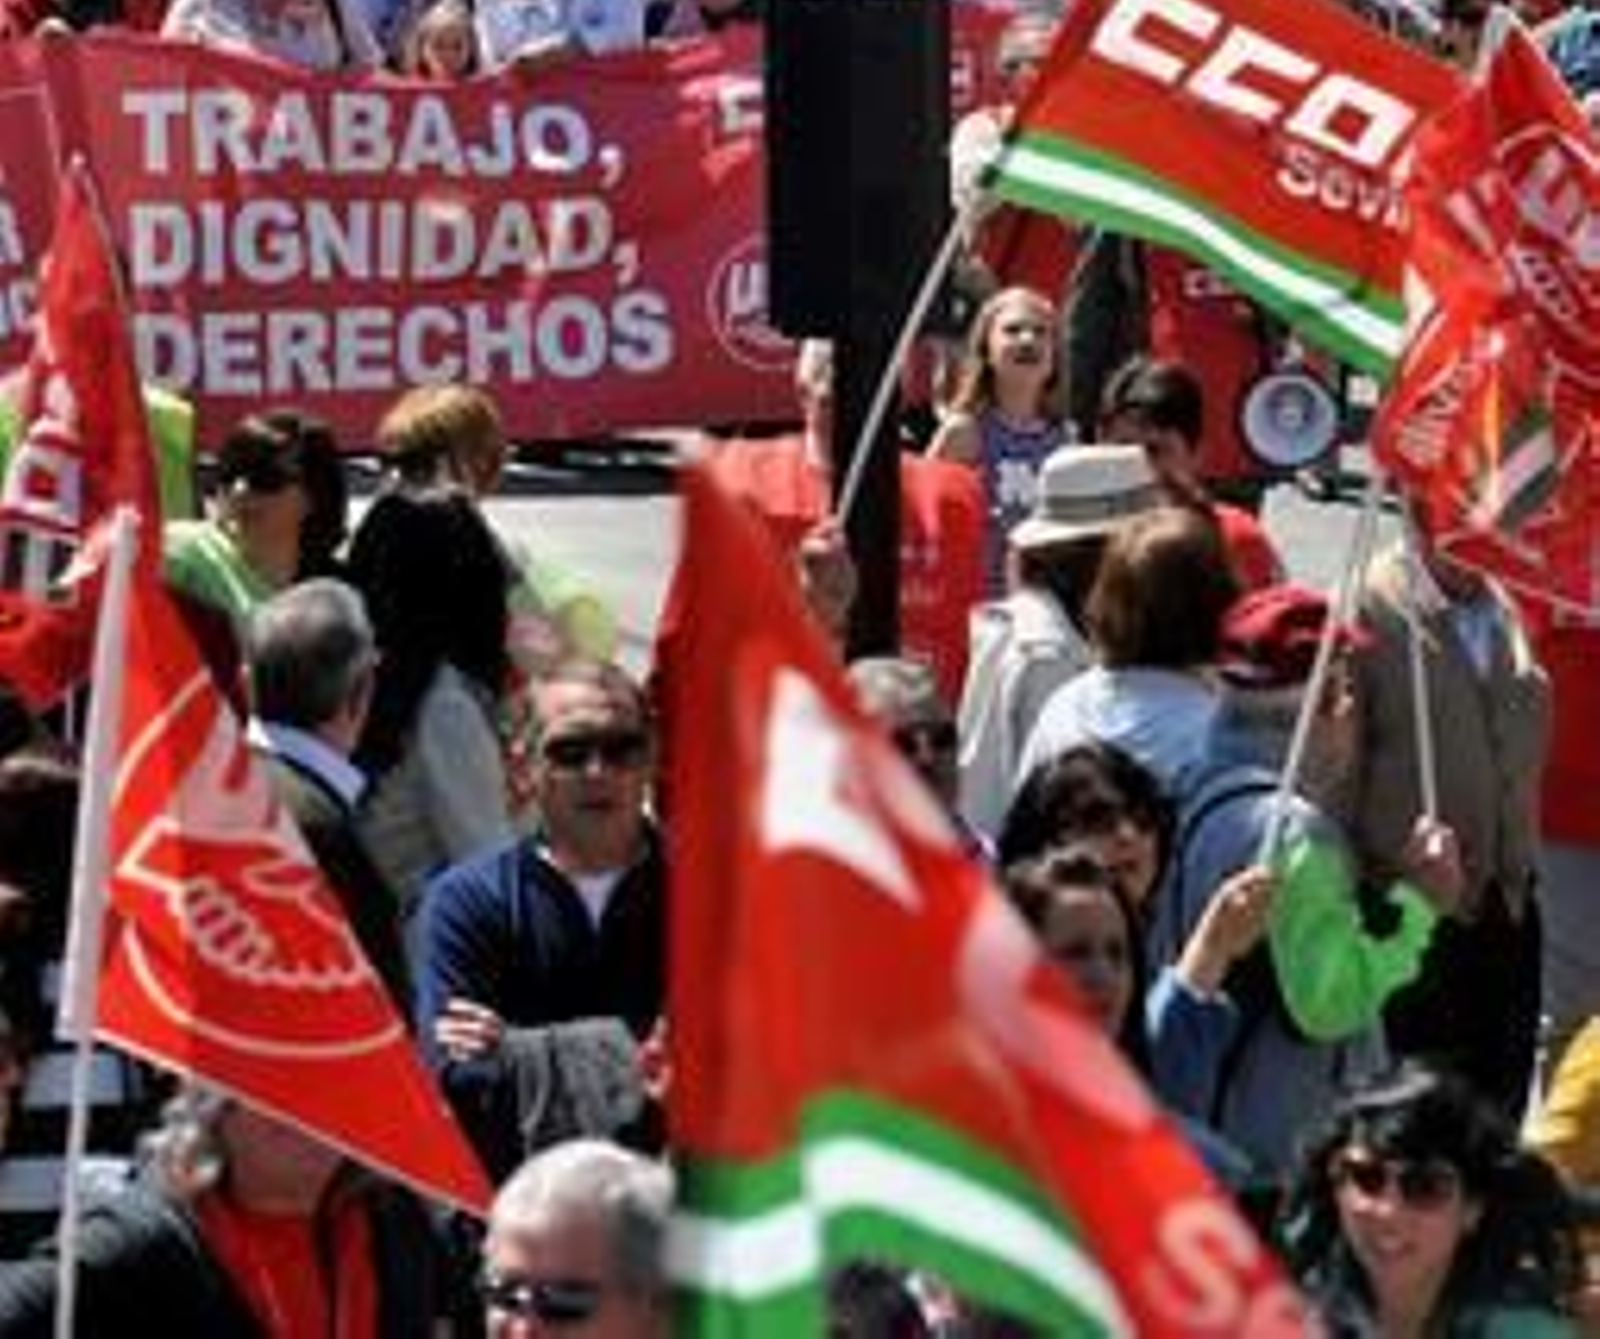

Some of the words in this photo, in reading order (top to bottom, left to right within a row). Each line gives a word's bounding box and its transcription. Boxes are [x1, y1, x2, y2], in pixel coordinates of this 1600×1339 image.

[122, 89, 624, 188] TRABAJO,
[128, 194, 640, 287] DIGNIDAD,
[133, 290, 676, 396] DERECHOS
